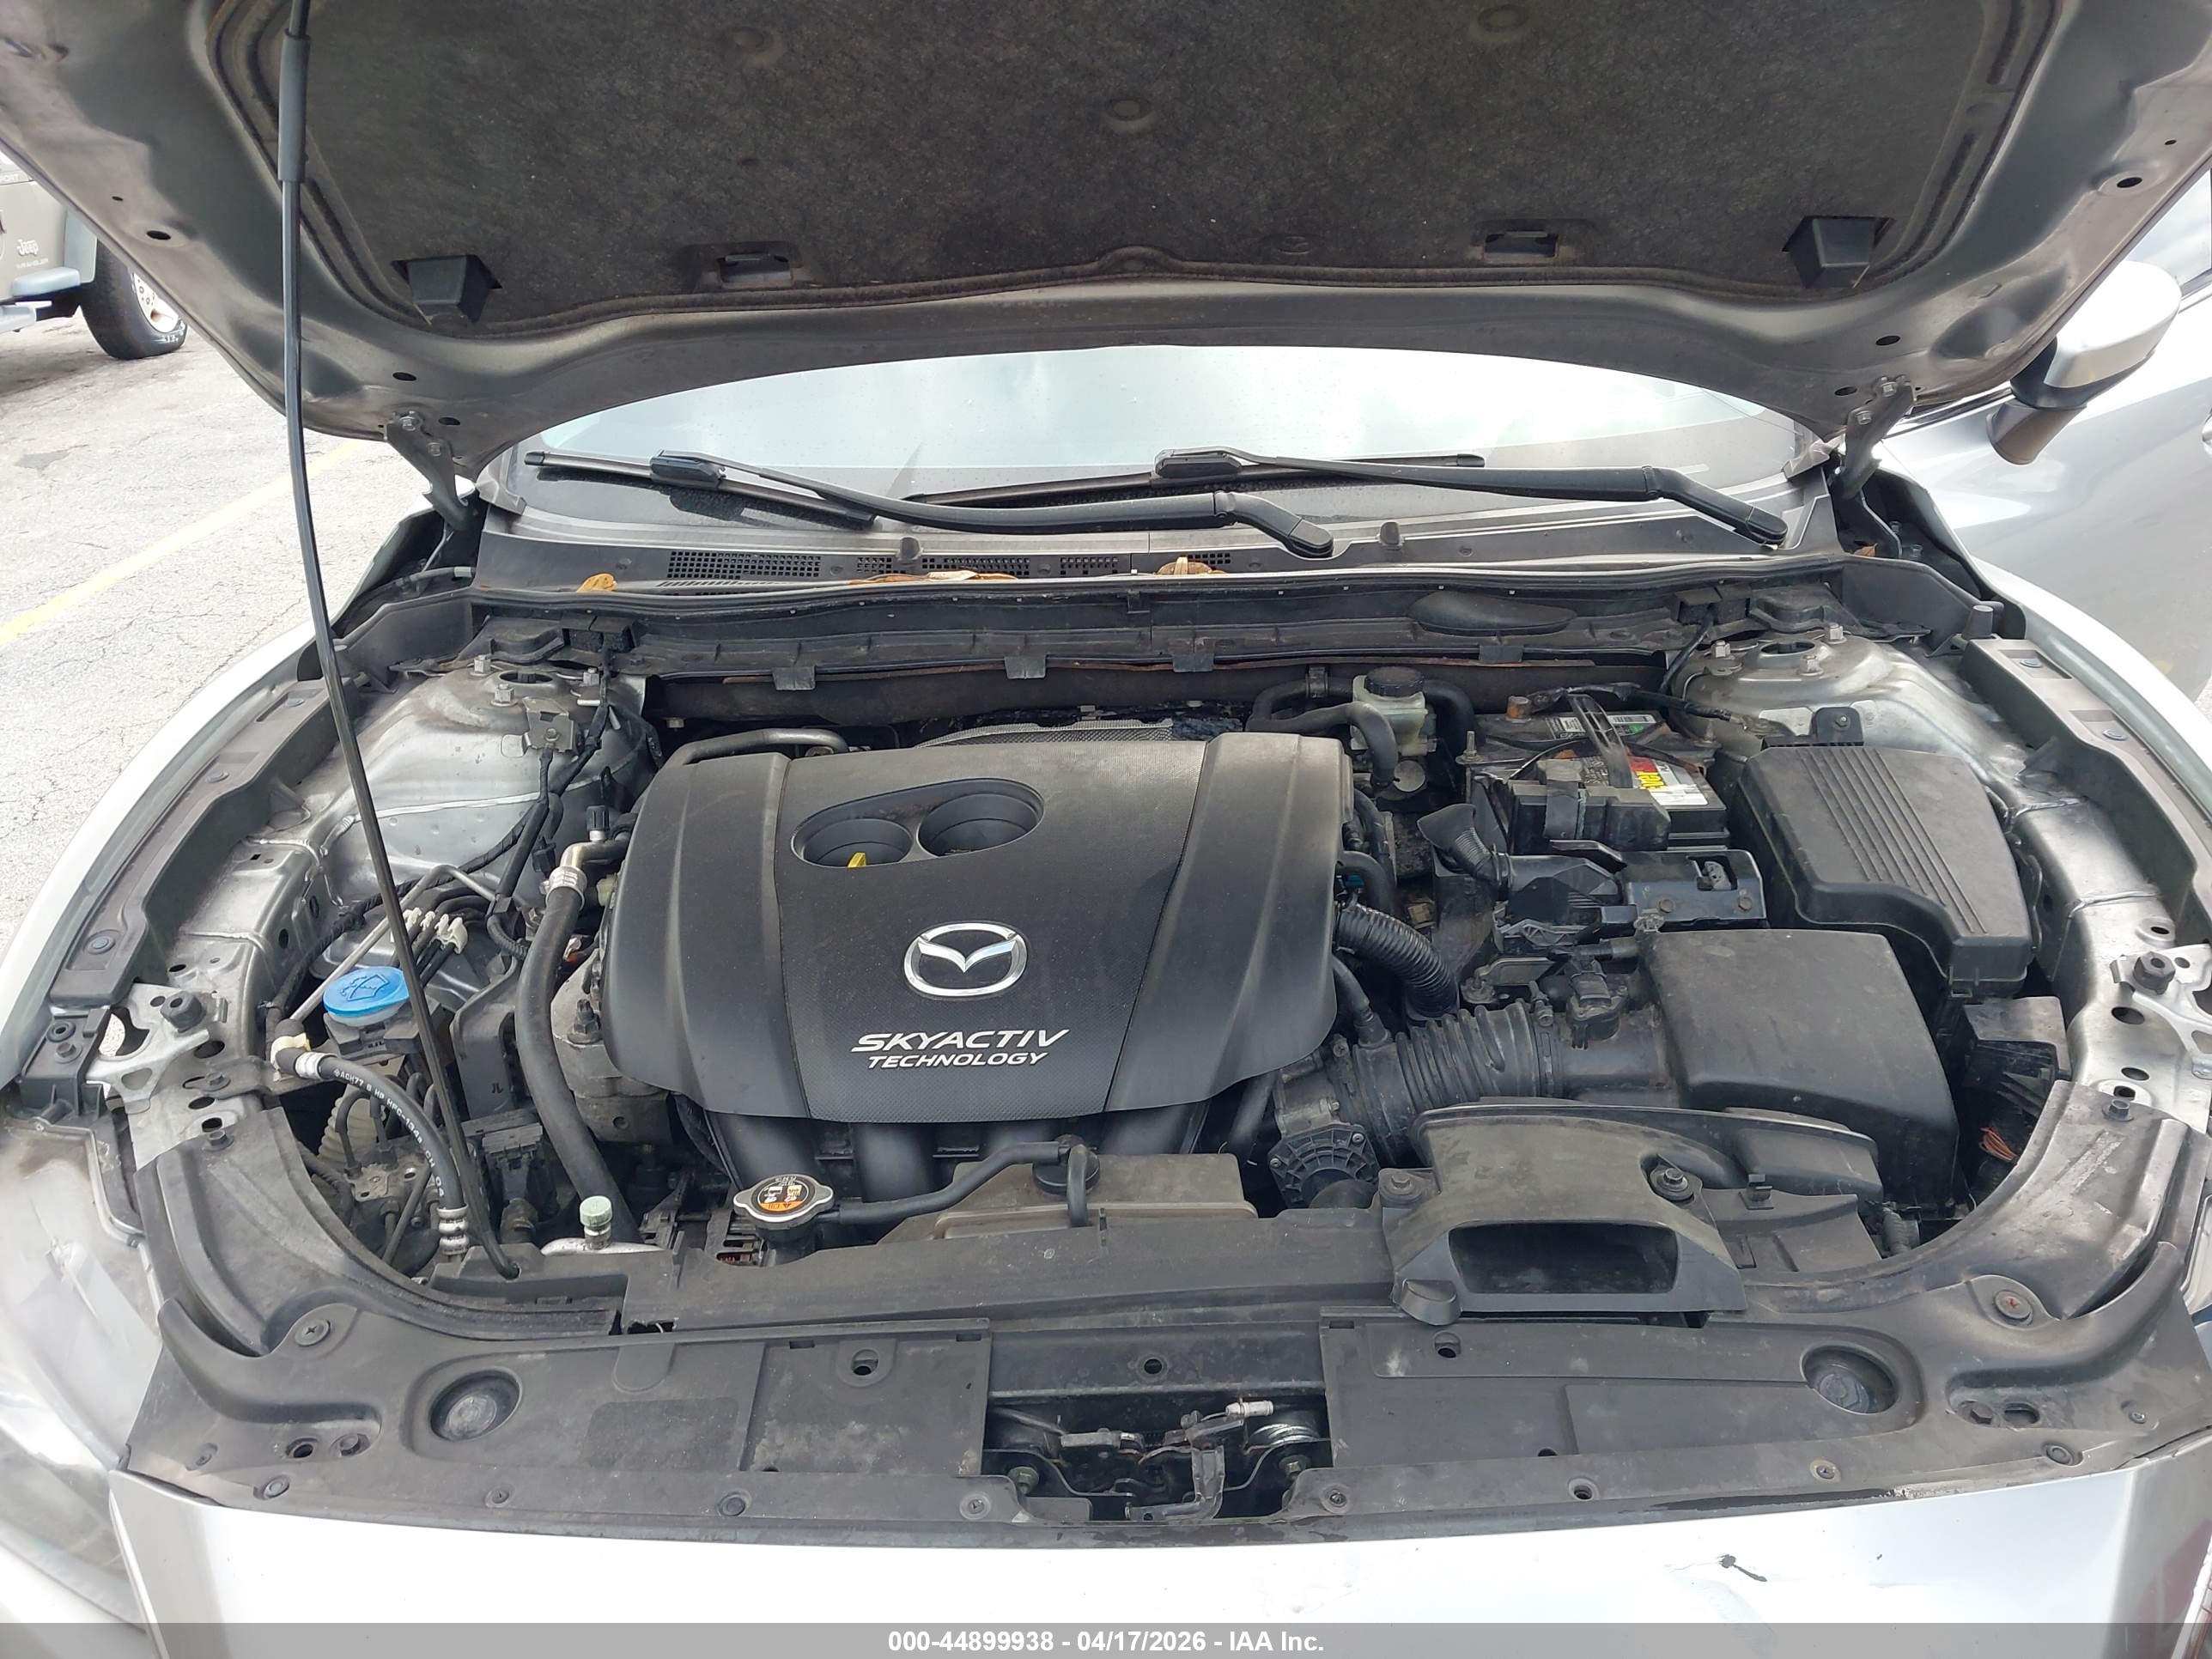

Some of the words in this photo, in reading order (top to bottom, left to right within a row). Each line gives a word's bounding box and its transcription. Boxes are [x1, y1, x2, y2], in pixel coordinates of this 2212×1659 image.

[17, 240, 39, 256] Jeep
[851, 1029, 1070, 1052] SKYACTIV
[868, 1052, 1048, 1069] TECHNOLOGY
